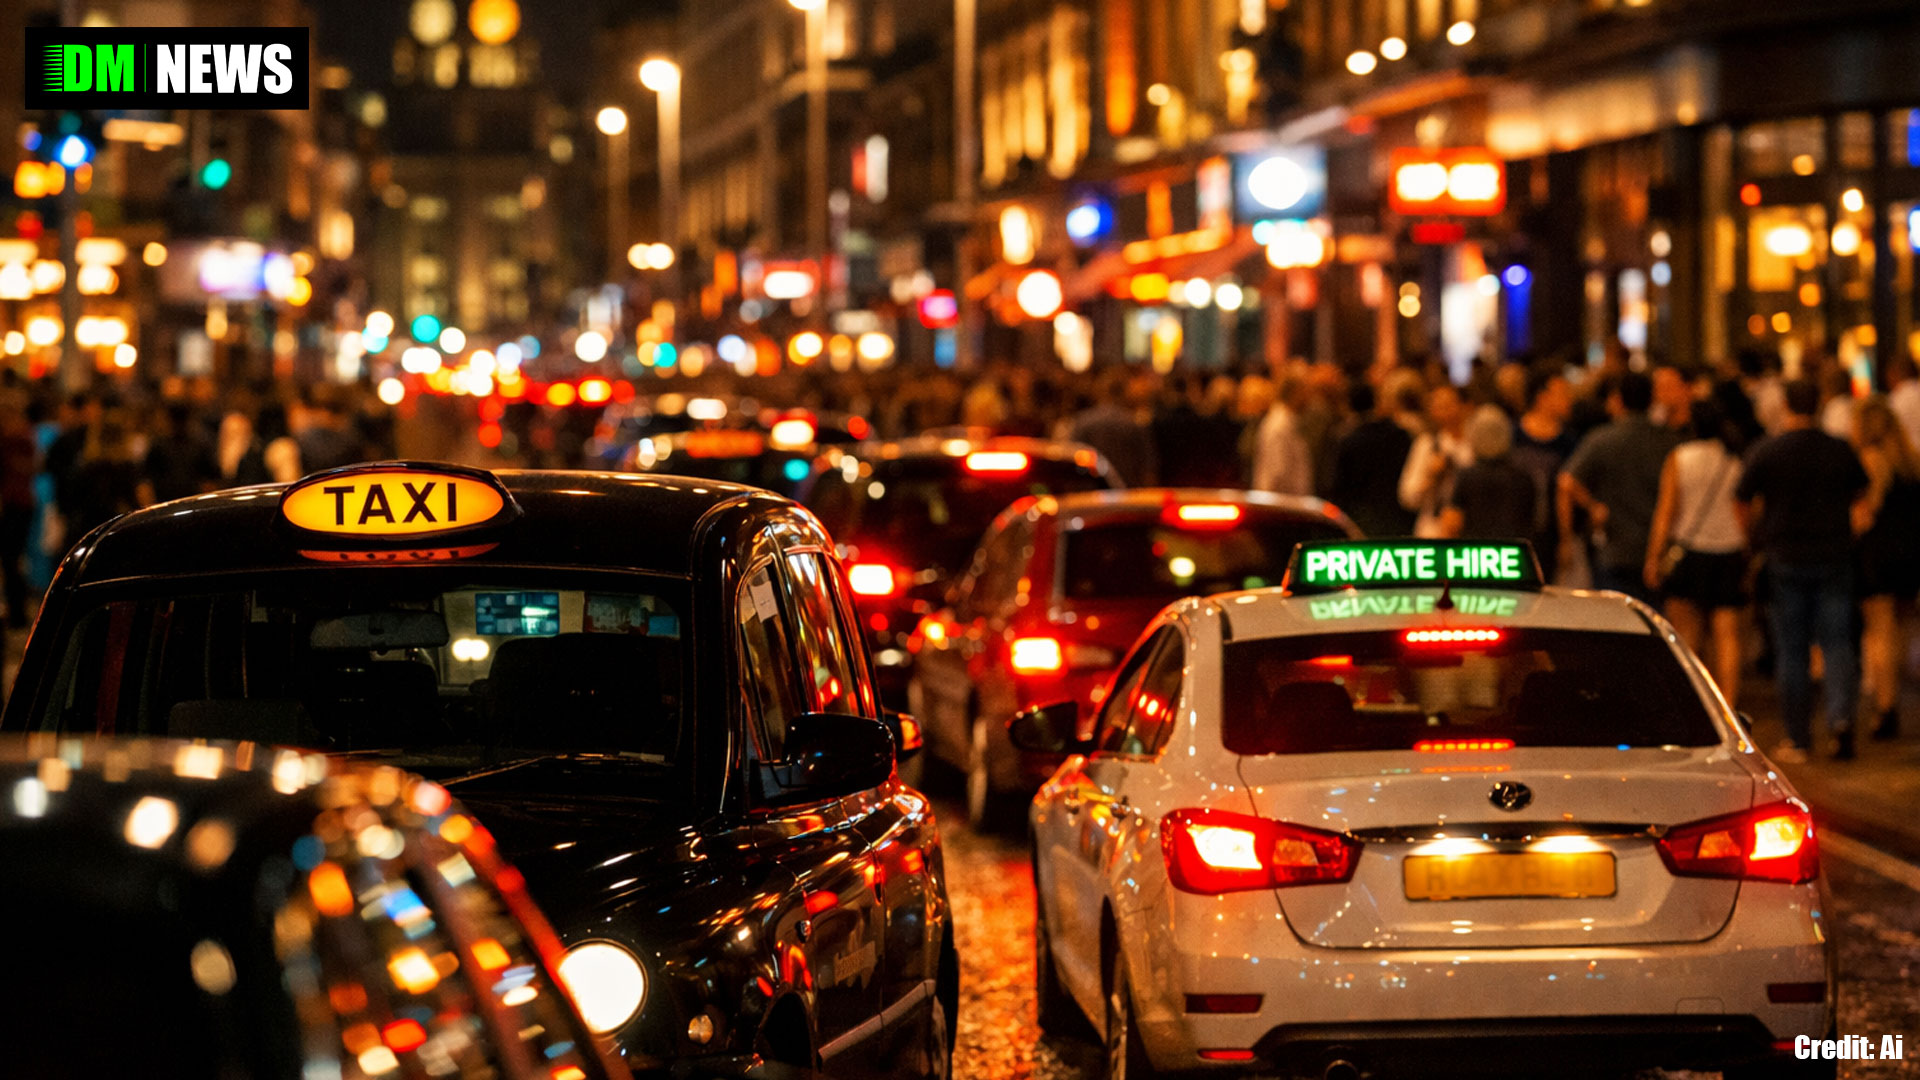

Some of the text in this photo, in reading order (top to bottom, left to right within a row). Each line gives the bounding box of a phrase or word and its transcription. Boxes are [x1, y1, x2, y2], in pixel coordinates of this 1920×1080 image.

[323, 482, 458, 526] TAXI
[1306, 547, 1521, 582] PRIVATE HIRE
